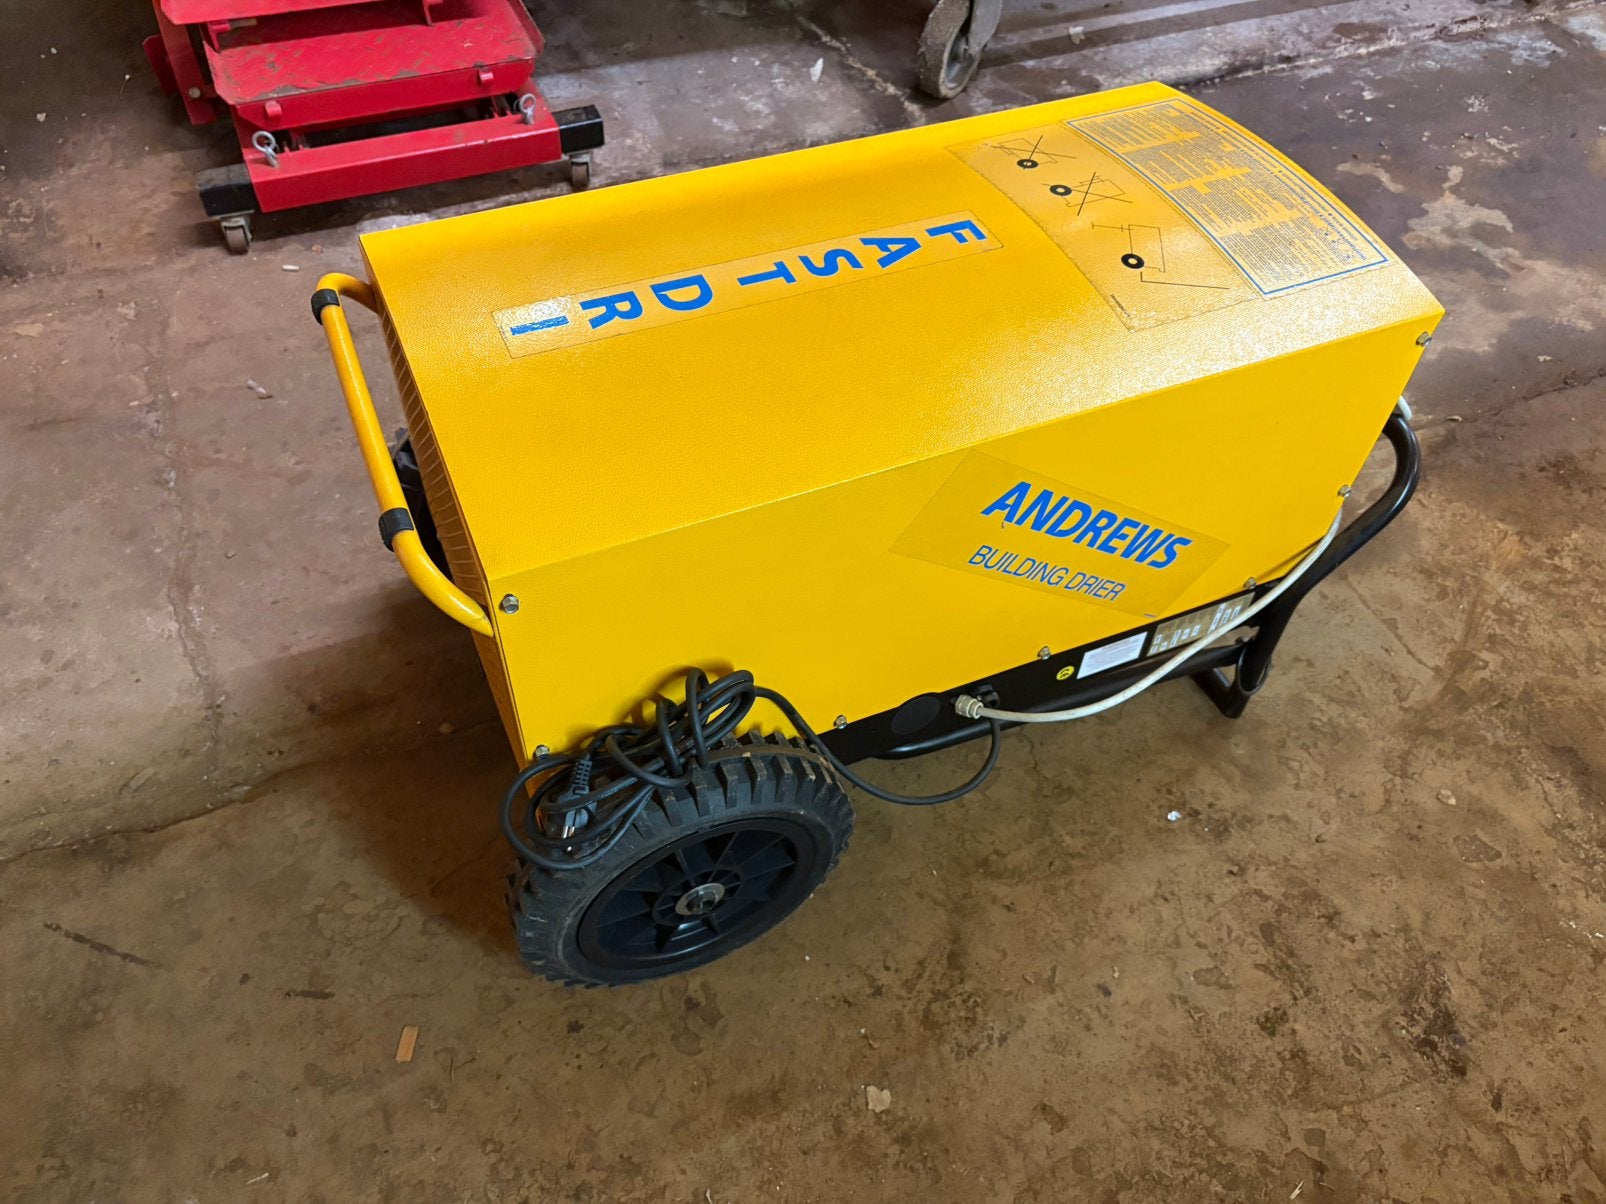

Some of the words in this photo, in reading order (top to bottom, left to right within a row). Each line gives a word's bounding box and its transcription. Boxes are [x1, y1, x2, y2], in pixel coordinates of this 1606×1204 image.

[980, 480, 1193, 570] ANDREWS
[968, 545, 1069, 587] BUILDING
[1063, 572, 1127, 601] DRIER
